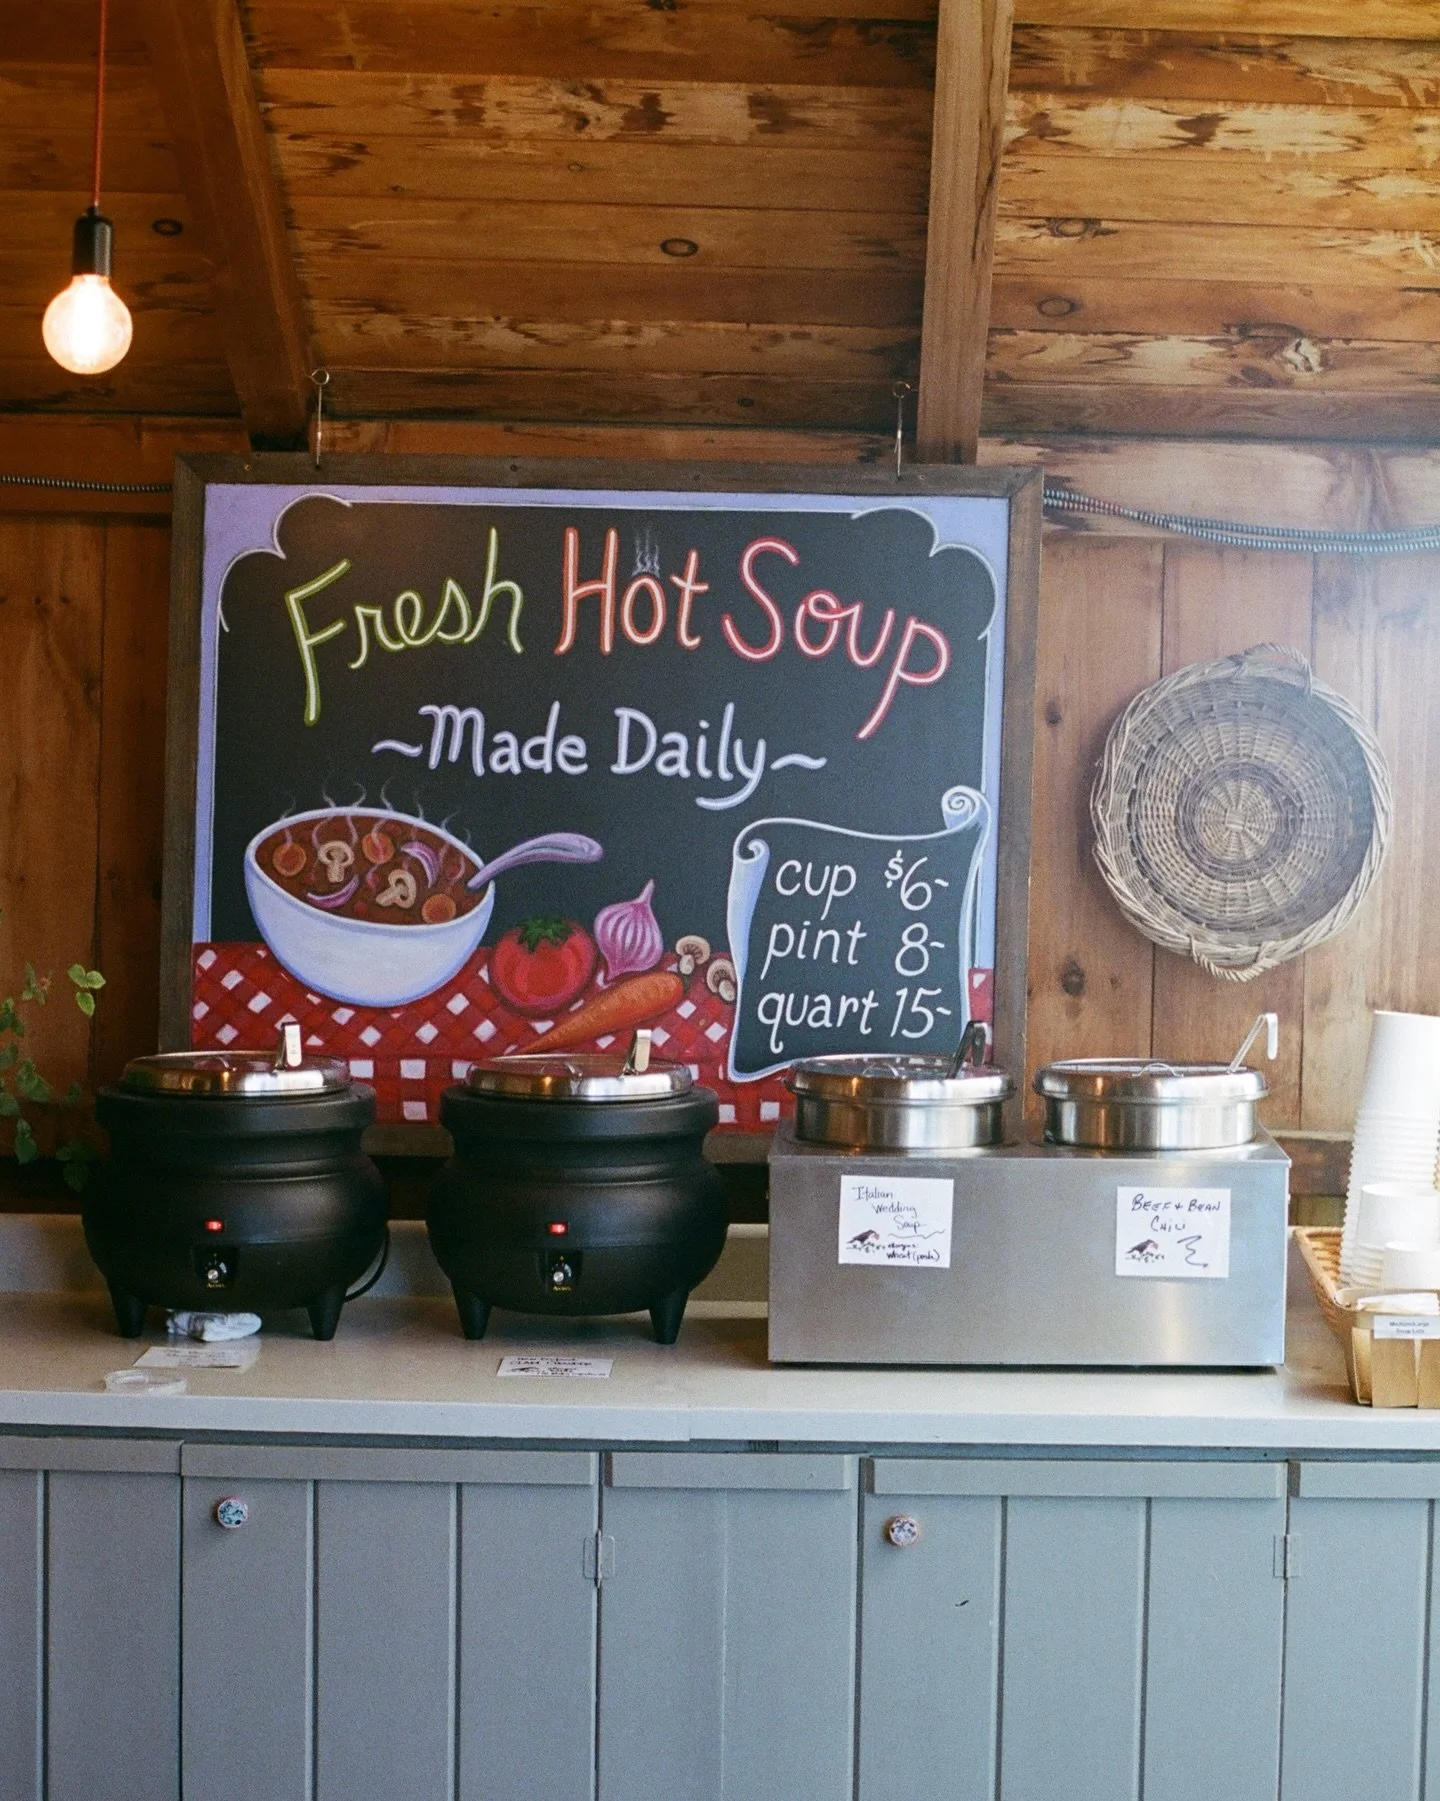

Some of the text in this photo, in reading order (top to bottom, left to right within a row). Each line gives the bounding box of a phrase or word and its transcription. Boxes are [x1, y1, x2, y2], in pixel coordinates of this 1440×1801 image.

[285, 527, 951, 740] Fresh Hot Soup
[775, 859, 857, 921] cup
[760, 920, 868, 981] pint
[757, 989, 879, 1054] quart
[851, 1186, 894, 1202] Italian
[872, 1201, 918, 1219] Wedding
[1131, 1193, 1172, 1212] BEEF
[1187, 1198, 1221, 1212] BEAN
[893, 1214, 924, 1234] Soup
